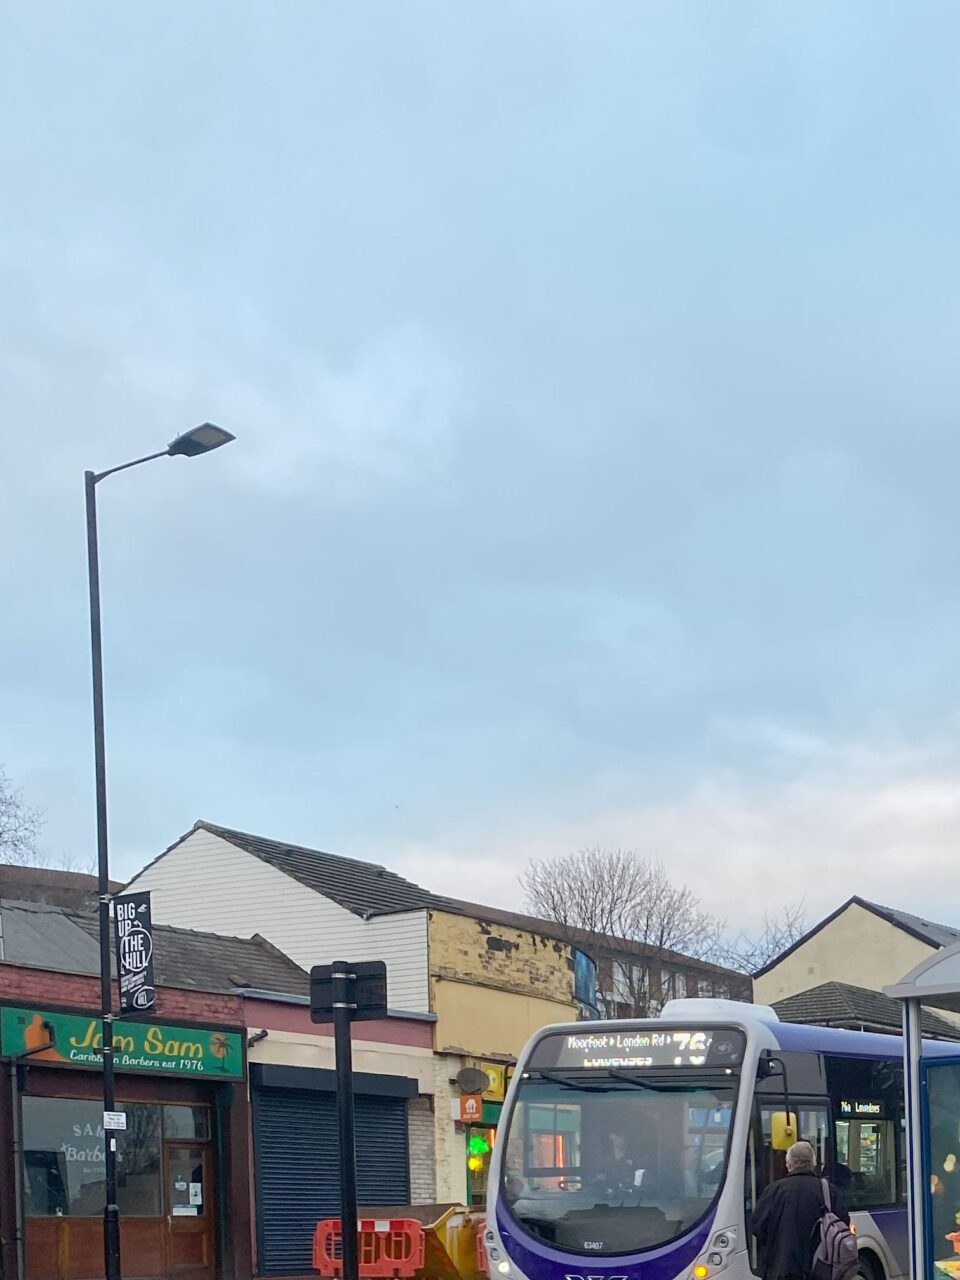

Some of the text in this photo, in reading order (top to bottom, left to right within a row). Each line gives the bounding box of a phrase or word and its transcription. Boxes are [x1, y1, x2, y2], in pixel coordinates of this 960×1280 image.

[116, 902, 136, 920] BIG
[118, 920, 132, 937] UP
[124, 934, 144, 953] THE
[125, 951, 148, 969] HILL
[144, 1027, 204, 1058] Sam
[567, 1035, 609, 1049] Moorfoot
[616, 1034, 650, 1048] London
[652, 1033, 665, 1047] Rd
[70, 1049, 119, 1064] Caribbn
[122, 1054, 160, 1068] Barbers
[179, 1058, 204, 1071] 1976
[584, 1241, 603, 1250] 63407
